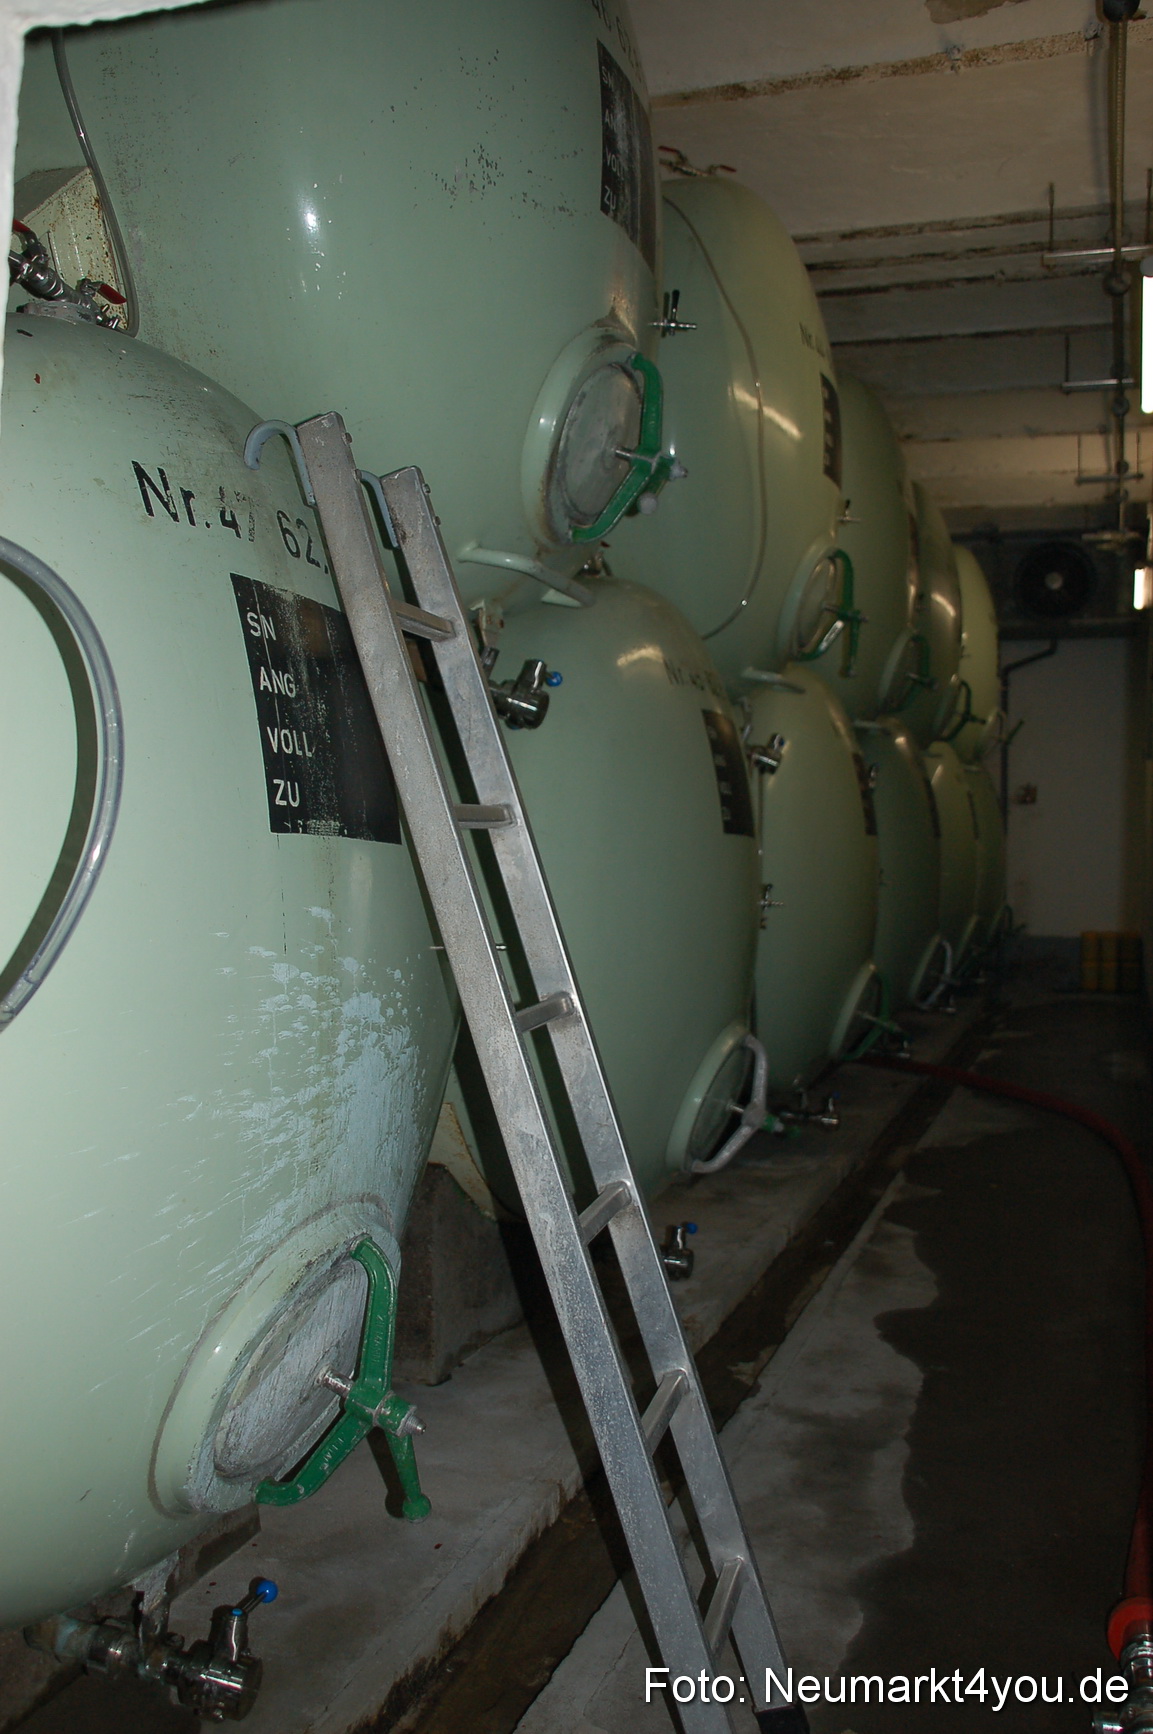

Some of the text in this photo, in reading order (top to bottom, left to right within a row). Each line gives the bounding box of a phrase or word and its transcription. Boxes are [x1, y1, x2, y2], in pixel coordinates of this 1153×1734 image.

[246, 611, 277, 641] SN
[259, 665, 297, 699] ANG
[266, 726, 314, 758] VOLL
[272, 778, 301, 808] ZU
